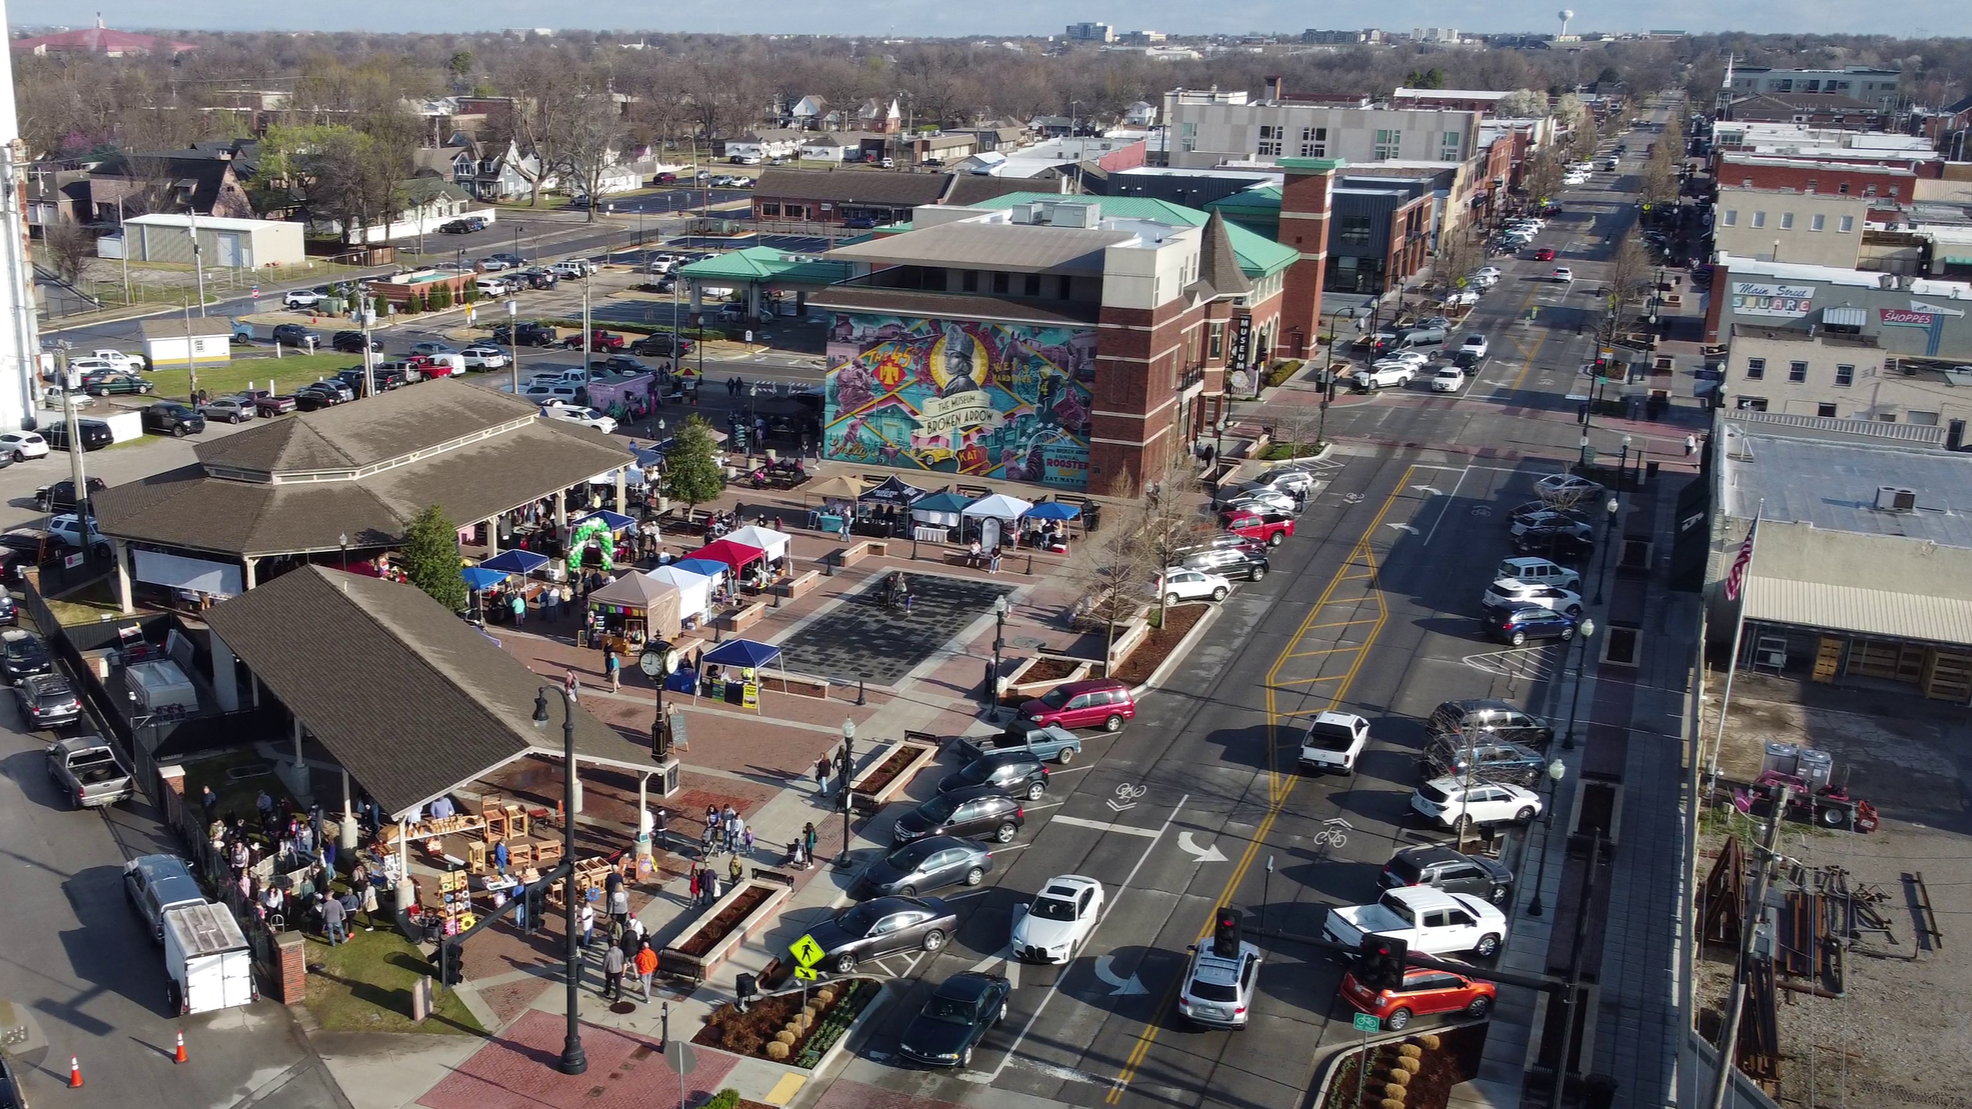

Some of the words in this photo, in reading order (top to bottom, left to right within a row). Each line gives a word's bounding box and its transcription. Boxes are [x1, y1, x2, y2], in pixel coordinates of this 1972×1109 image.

[1739, 283, 1769, 295] Main
[1776, 285, 1807, 297] Street
[1732, 296, 1810, 312] SUARE
[1883, 312, 1931, 324] SHOPPES
[1235, 319, 1249, 370] MUSEUM
[867, 350, 890, 366] THE
[937, 400, 950, 413] THE
[951, 394, 976, 408] MUSEUM
[927, 412, 961, 435] BROKEN
[964, 410, 994, 423] ARROW
[958, 447, 985, 462] KATY
[1046, 458, 1089, 470] ROOSTER
